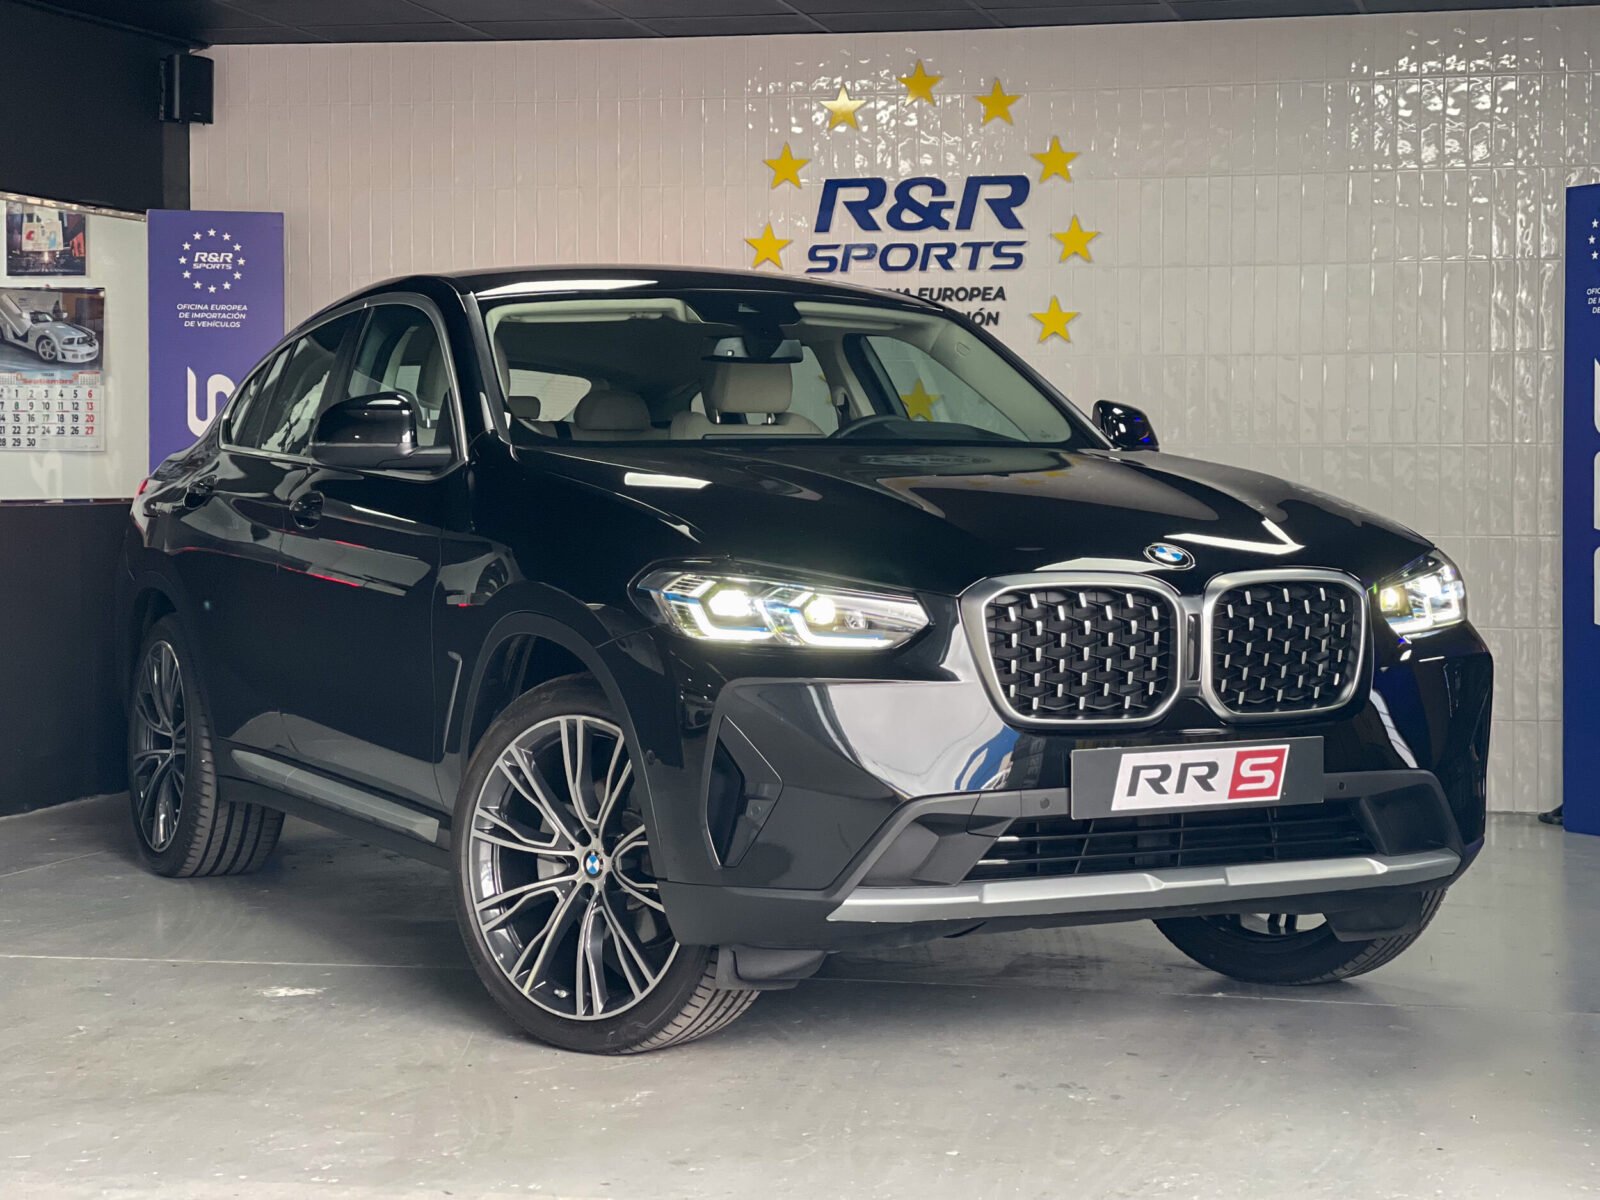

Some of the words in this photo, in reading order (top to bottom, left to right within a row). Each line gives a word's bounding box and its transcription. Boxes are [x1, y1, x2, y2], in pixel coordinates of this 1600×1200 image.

[814, 174, 1031, 233] R&R
[193, 251, 234, 263] R&R
[804, 240, 1028, 274] SPORTS
[192, 262, 233, 270] SPORTS
[917, 285, 1007, 302] EUROPEA
[176, 303, 209, 311] OFICINA
[178, 311, 190, 319] DE
[191, 312, 246, 320] IMPORTACIÓN
[196, 320, 241, 328] VEHÍCULOS
[44, 389, 49, 399] 3
[58, 389, 64, 399] 4
[73, 389, 78, 399] 5
[87, 389, 93, 399] 6
[14, 401, 20, 410] 8
[29, 401, 34, 410] 9
[42, 401, 50, 410] 10
[58, 401, 64, 410] 11
[72, 401, 79, 411] 12
[86, 401, 94, 411] 13
[13, 413, 21, 422] 15
[27, 413, 35, 422] 16
[57, 413, 65, 423] 18
[71, 414, 79, 423] 19
[85, 414, 95, 423] 20
[12, 425, 21, 435] 22
[27, 425, 36, 435] 23
[41, 426, 51, 435] 24
[56, 426, 65, 435] 25
[70, 426, 79, 435] 26
[85, 426, 94, 436] 27
[12, 437, 21, 447] 29
[26, 437, 36, 447] 30
